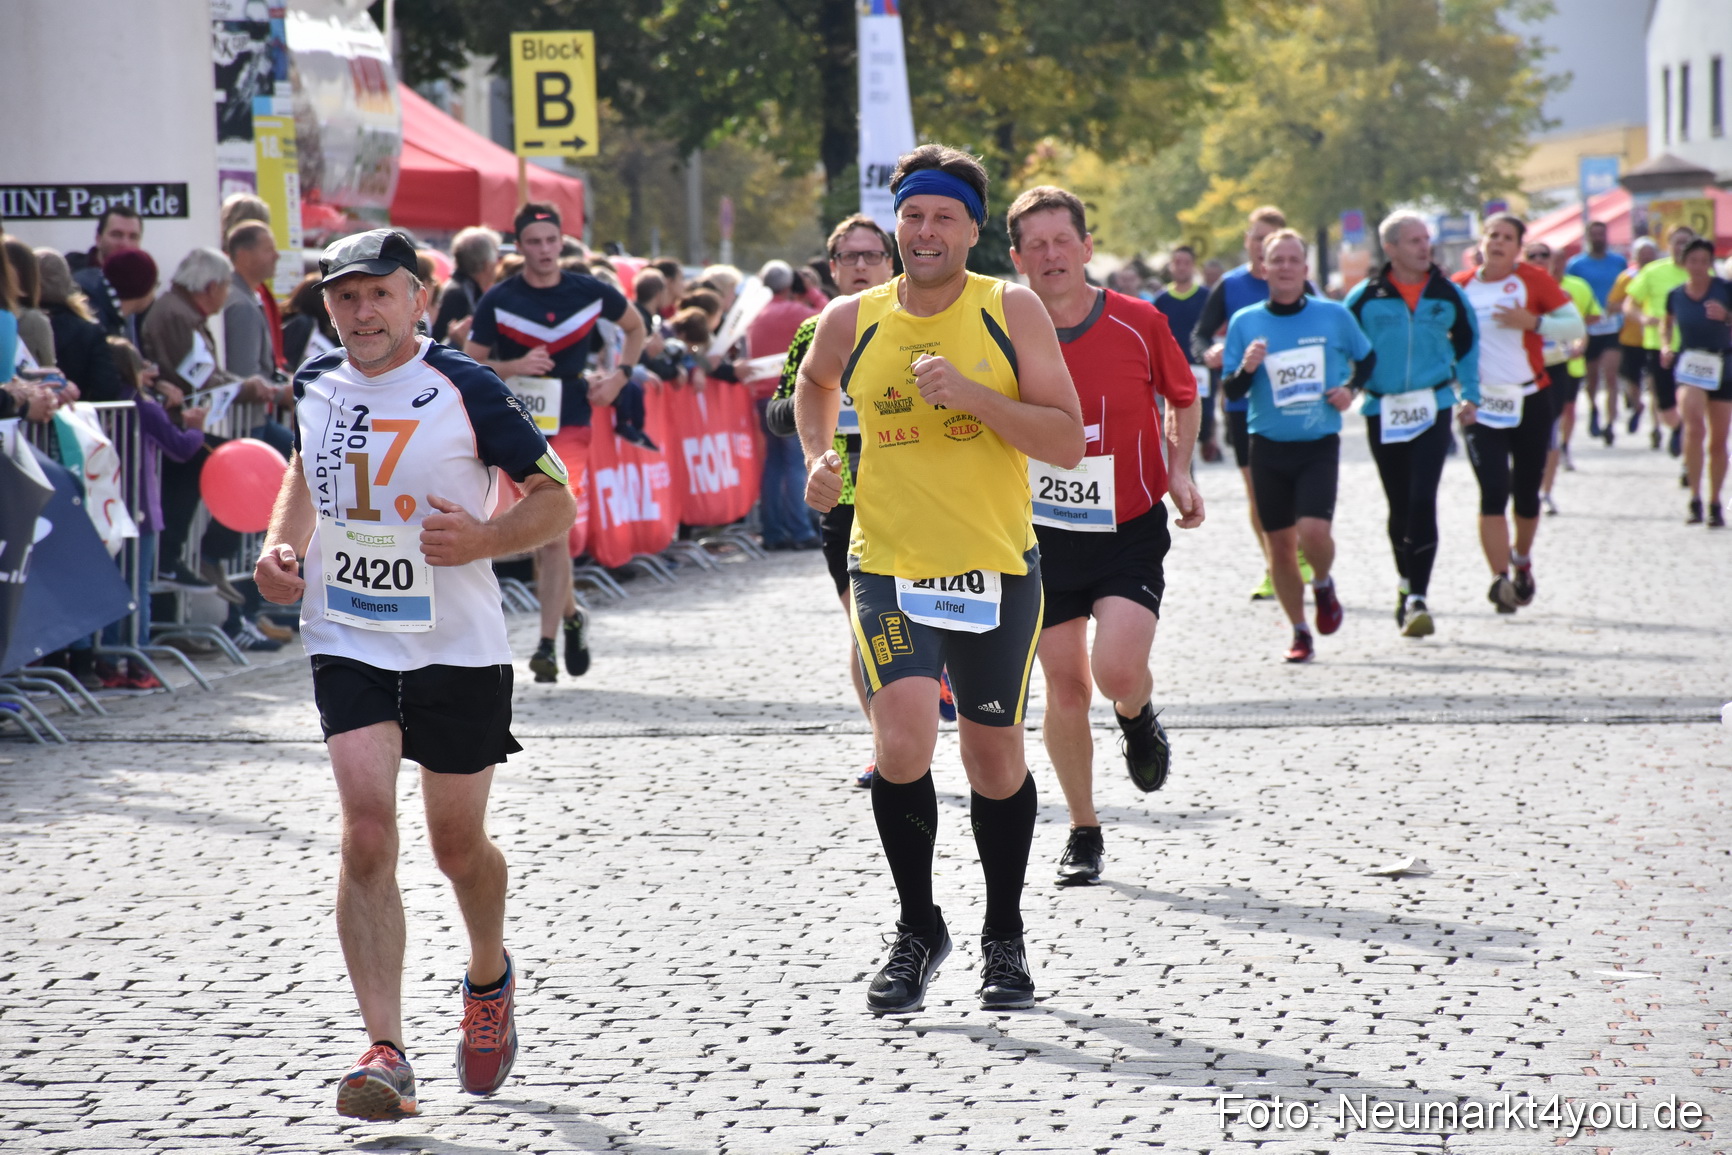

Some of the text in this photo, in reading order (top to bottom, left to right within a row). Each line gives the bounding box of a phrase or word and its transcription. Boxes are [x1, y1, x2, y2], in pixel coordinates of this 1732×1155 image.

[522, 38, 584, 61] Block
[536, 71, 576, 129] B
[1276, 363, 1317, 385] 2922
[943, 414, 983, 428] PIZZERIA
[1390, 406, 1430, 426] 2348
[878, 426, 920, 444] M & S
[951, 424, 979, 436] ELIO
[329, 420, 347, 470] LAUF
[1039, 476, 1100, 505] 2534
[1053, 508, 1088, 519] Gerhard
[356, 533, 395, 545] BOCK
[335, 551, 414, 591] 2420
[351, 597, 398, 613] Klemens
[934, 600, 965, 614] Alfred
[885, 616, 909, 651] Run!
[876, 636, 889, 661] Team
[977, 704, 1006, 714] adidas
